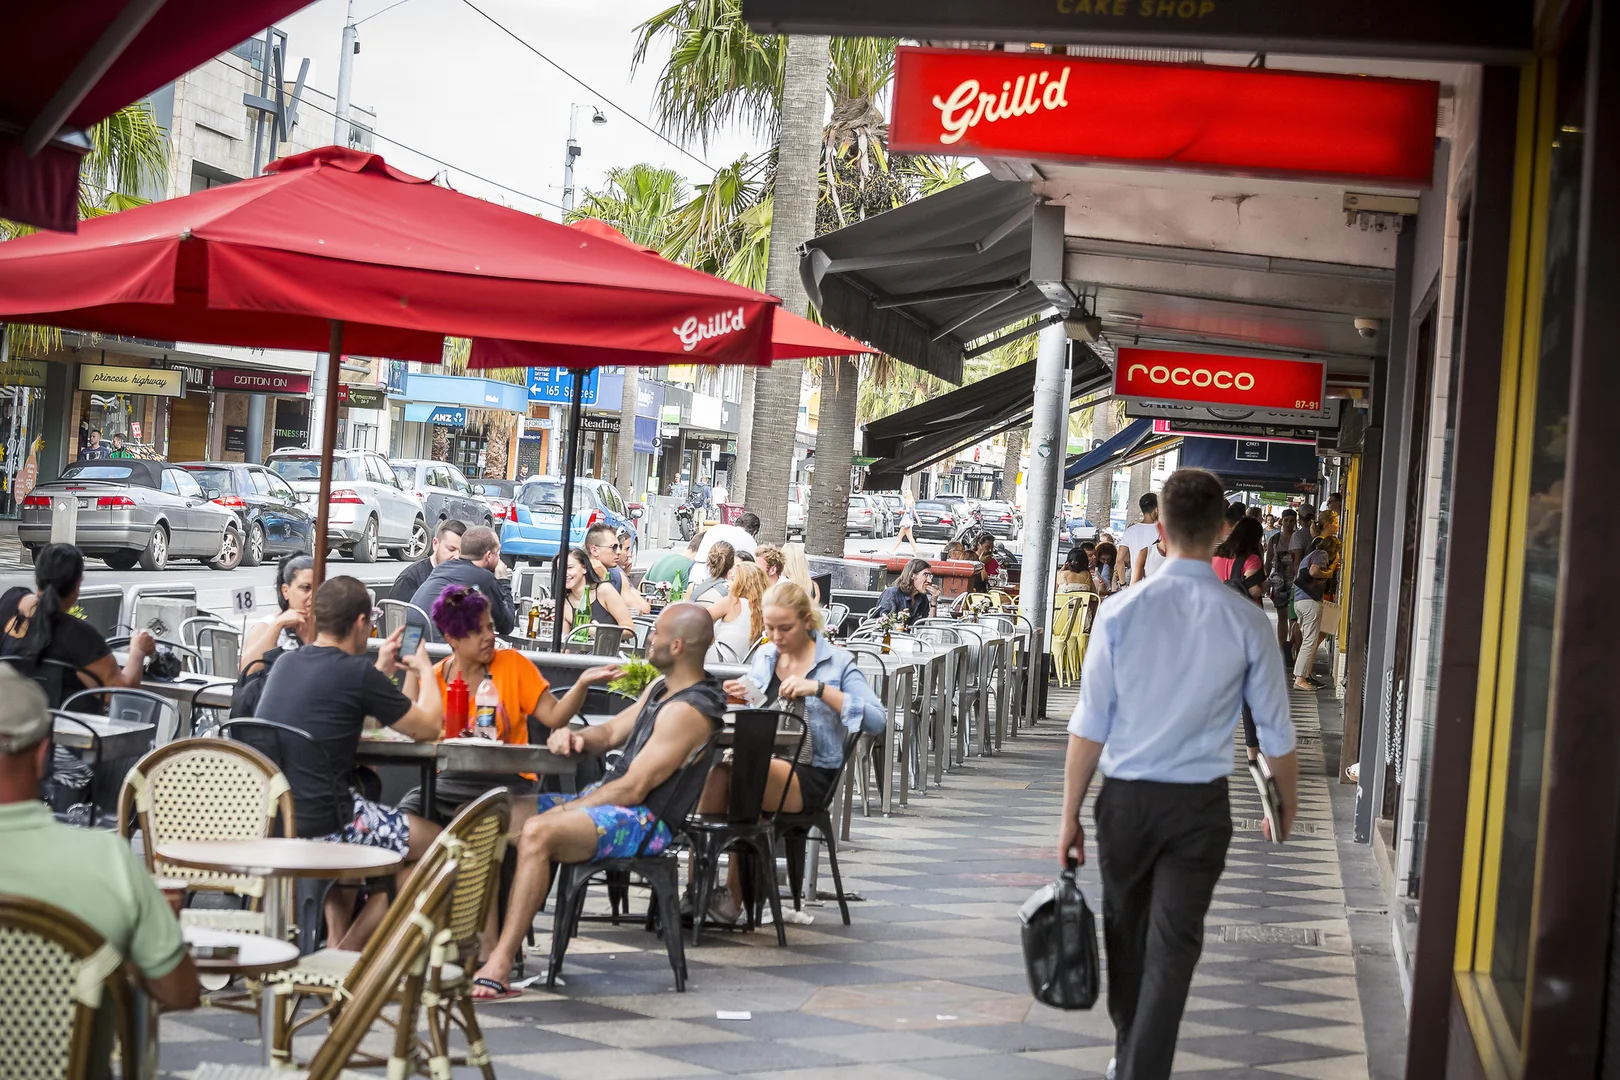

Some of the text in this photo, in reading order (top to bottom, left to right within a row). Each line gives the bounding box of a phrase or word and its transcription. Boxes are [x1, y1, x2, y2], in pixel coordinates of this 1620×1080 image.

[1056, 0, 1217, 18] CAKE SHOP
[932, 66, 1071, 144] Grill'd
[672, 306, 746, 352] Grill'd
[92, 371, 129, 383] princess
[131, 373, 168, 388] highway
[233, 375, 288, 388] COTTON ON
[1127, 363, 1255, 391] rococo
[545, 385, 594, 399] 165 Spces
[1294, 400, 1320, 410] 87-91
[431, 413, 453, 423] ANZ
[235, 591, 252, 610] 18
